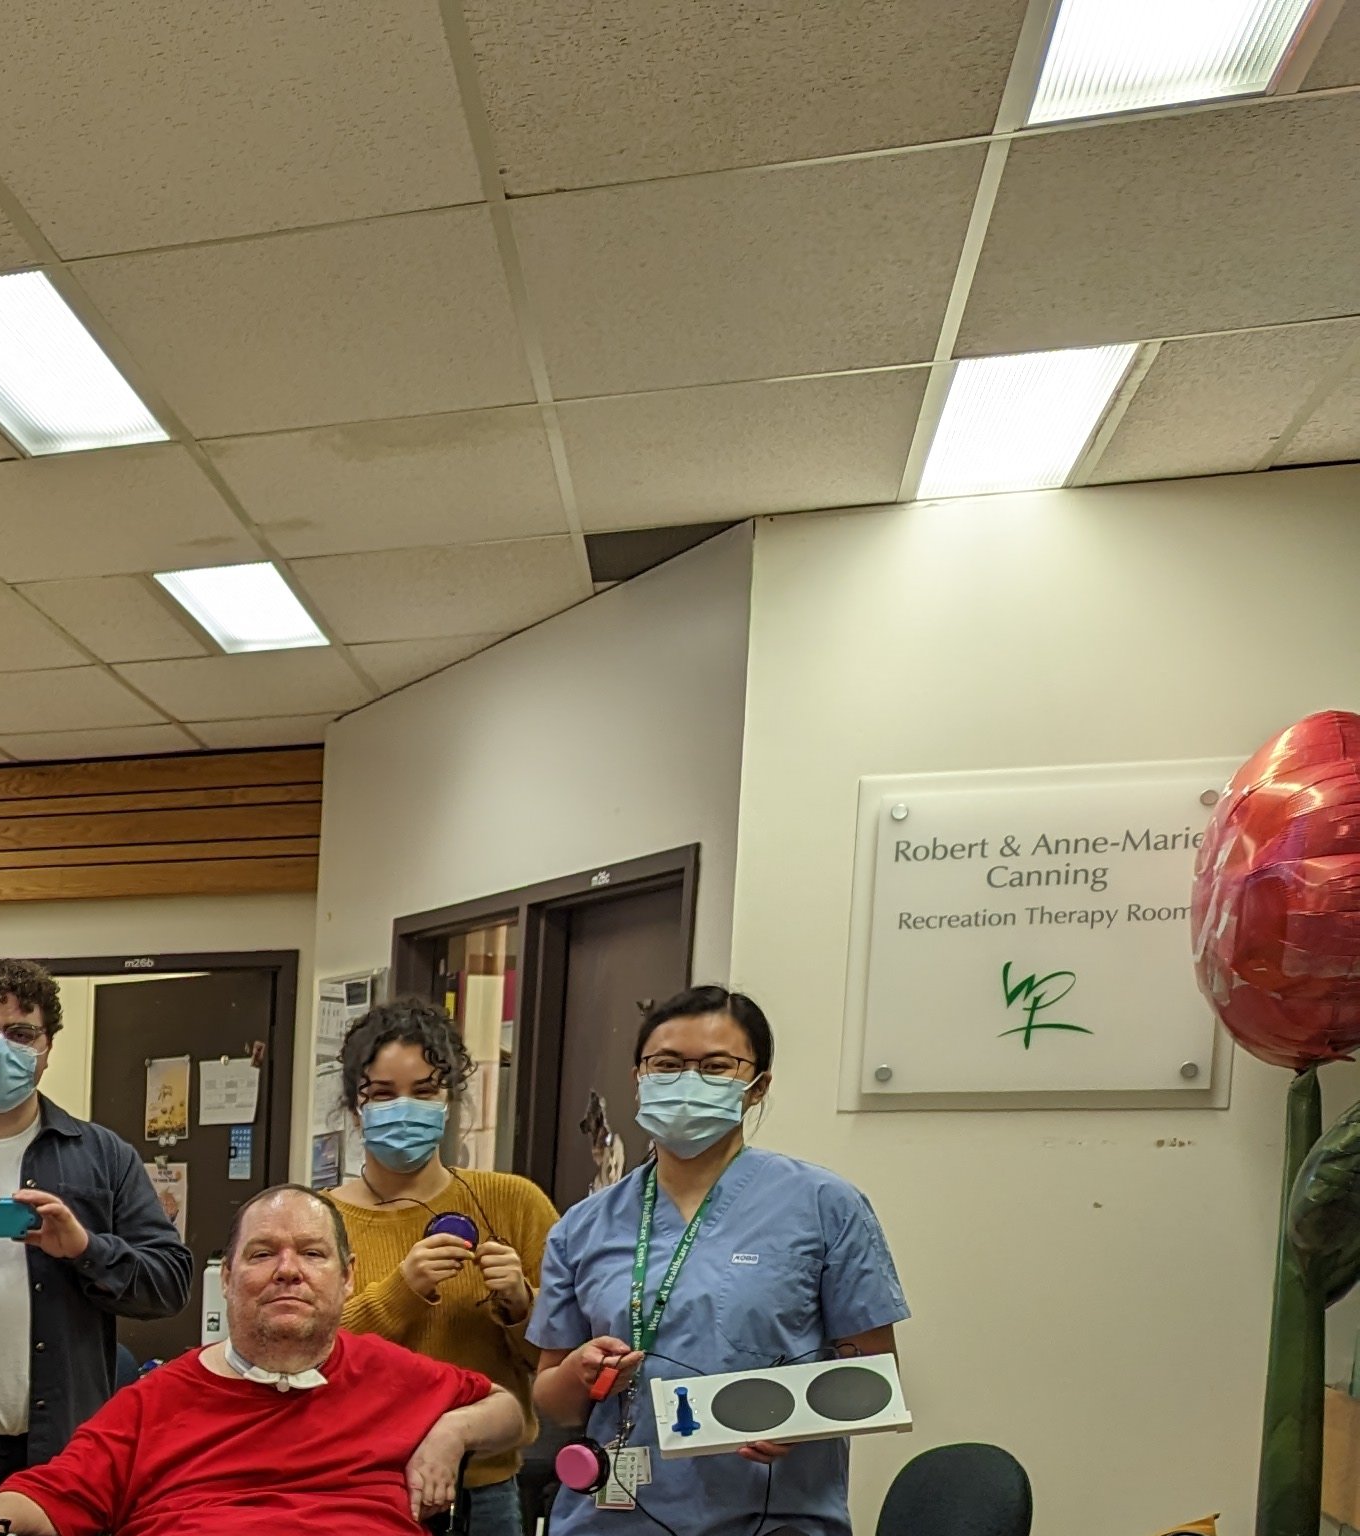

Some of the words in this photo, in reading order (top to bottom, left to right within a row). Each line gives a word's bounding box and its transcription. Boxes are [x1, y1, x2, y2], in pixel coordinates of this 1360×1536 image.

[894, 835, 989, 864] Robert
[999, 835, 1022, 858] &
[1031, 826, 1204, 857] Anne-Marie
[986, 863, 1109, 892] Canning
[898, 908, 1016, 931] Recreation
[1025, 904, 1119, 929] Therapy
[665, 1245, 689, 1289] Healthcare
[684, 1215, 701, 1243] Centre
